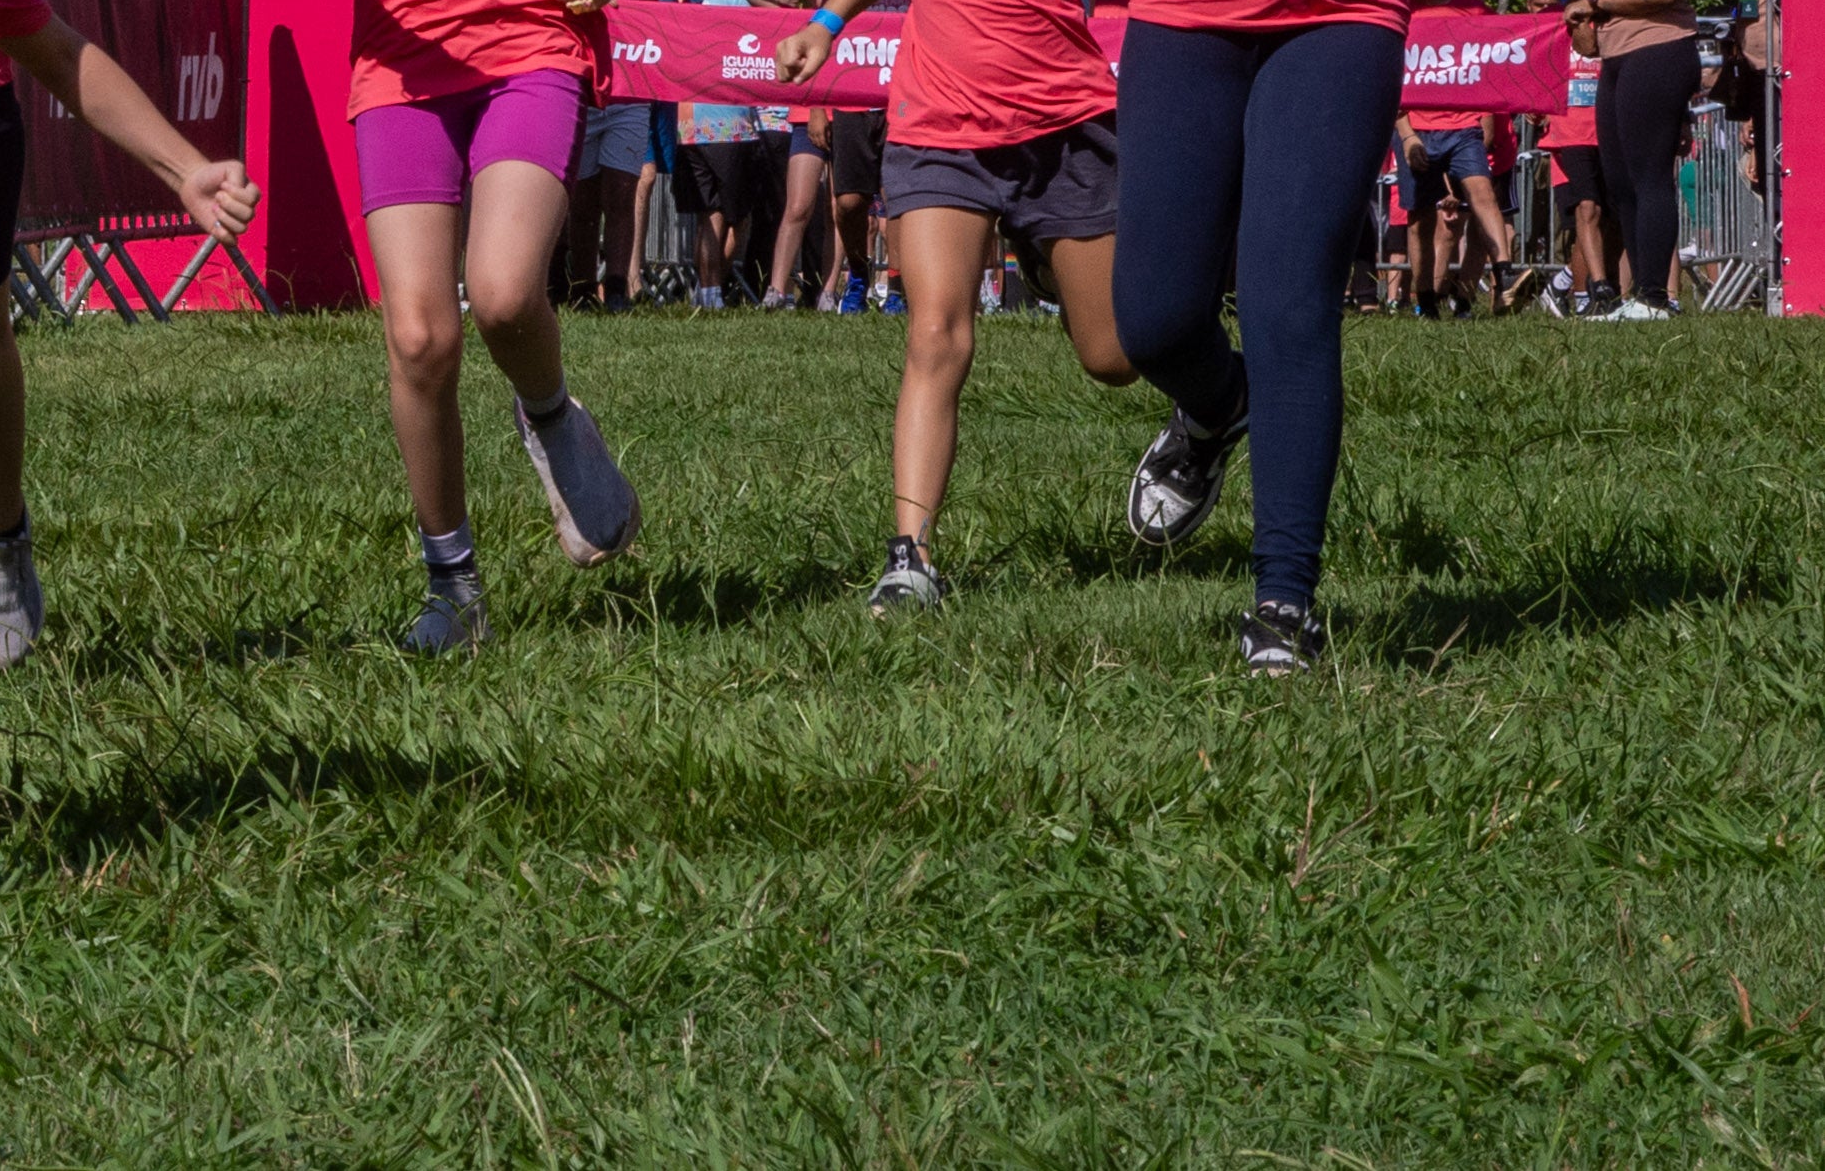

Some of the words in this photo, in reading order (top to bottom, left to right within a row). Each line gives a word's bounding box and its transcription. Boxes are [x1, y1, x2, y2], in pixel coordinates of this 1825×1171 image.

[612, 38, 662, 64] rvb
[722, 55, 775, 68] IGUANA
[1461, 37, 1527, 70] KIDS
[177, 31, 225, 122] rvb
[721, 67, 775, 80] SPORTS
[1414, 64, 1481, 86] FASTER
